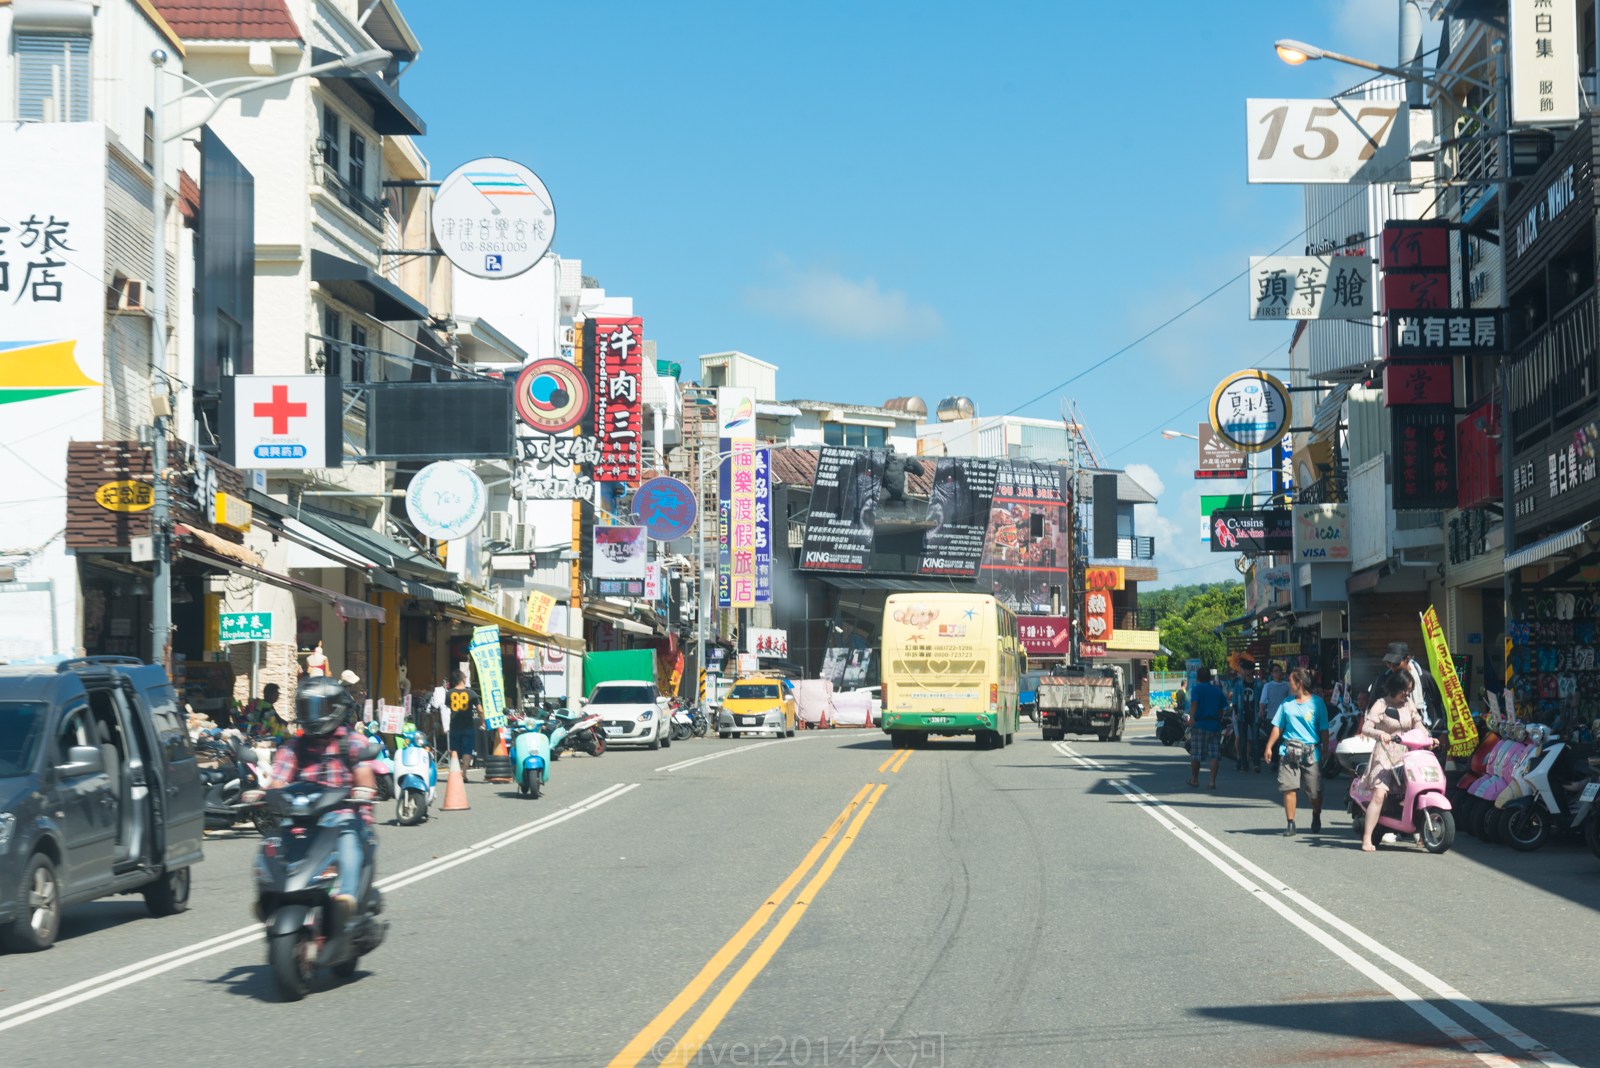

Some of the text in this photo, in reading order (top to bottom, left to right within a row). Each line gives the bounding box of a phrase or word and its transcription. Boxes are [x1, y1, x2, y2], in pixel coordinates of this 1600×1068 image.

[1539, 80, 1554, 112] 服飾
[1257, 106, 1400, 160] 157
[1516, 205, 1538, 259] BLACK
[1547, 164, 1575, 222] WHITE
[441, 217, 547, 241] 津津音樂客棧
[460, 241, 527, 252] 08-8861009
[1256, 266, 1367, 309] 頭等艙
[1256, 307, 1313, 316] FIRST CLASS
[1397, 316, 1496, 347] 尚有空房
[599, 341, 608, 394] Noodles
[609, 324, 638, 439] 牛肉三
[599, 397, 608, 438] House
[1433, 427, 1449, 494] 台式熱炒
[996, 486, 1061, 499] YOU CAN DRINK
[733, 442, 753, 603] 福樂渡假旅店
[1227, 518, 1264, 529] Cousins
[1236, 528, 1264, 538] Maine
[719, 499, 731, 603] Formost Hotel
[806, 551, 829, 562] KING
[922, 557, 944, 568] KING
[1302, 548, 1327, 558] VISA
[1087, 570, 1118, 588] 100
[222, 615, 264, 630] 和平巷
[1088, 594, 1107, 637] 熱炒
[223, 630, 250, 640] Heping
[450, 691, 469, 711] 88
